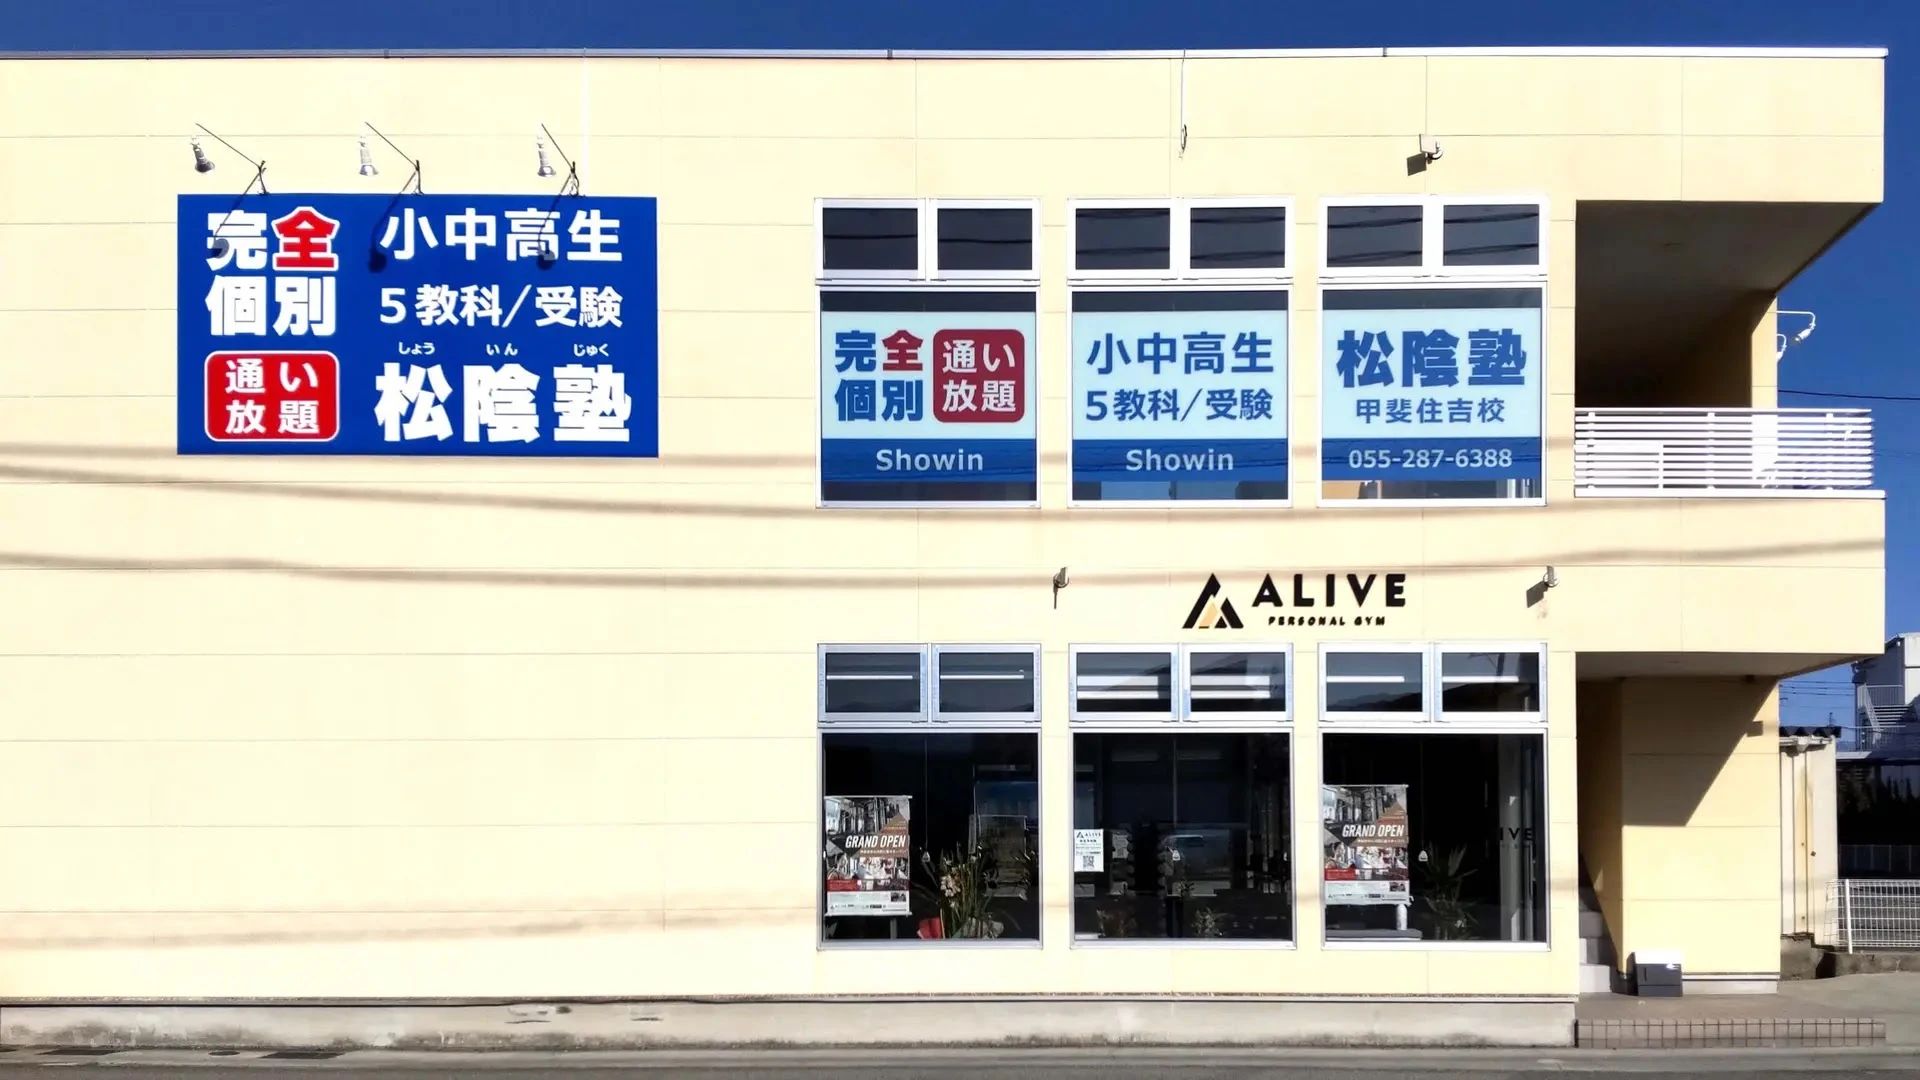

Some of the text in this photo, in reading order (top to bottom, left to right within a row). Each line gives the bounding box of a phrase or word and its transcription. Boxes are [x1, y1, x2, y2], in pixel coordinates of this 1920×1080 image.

[207, 207, 339, 271] 完全
[380, 208, 622, 261] 小中高生
[206, 275, 336, 336] 個別
[398, 342, 609, 356] しょう いん じゅく
[835, 330, 923, 372] 完全
[942, 339, 1016, 373] 通い
[1087, 331, 1274, 375] 小中高生
[1337, 329, 1527, 388] 松陰塾
[225, 358, 319, 394] 通い
[375, 363, 631, 442] 松陰塾
[835, 379, 923, 421] 個別
[942, 379, 1016, 412] 放題
[1356, 398, 1505, 424] 甲斐住吉校
[225, 399, 319, 434] 放題
[876, 448, 983, 471] Showin
[1126, 448, 1234, 471] Showin
[1349, 449, 1513, 468] 055-287-6388
[1252, 573, 1406, 607] ALIVE
[1268, 616, 1386, 626] PERSONAL GYM
[845, 835, 907, 848] GRAND OPEN
[1342, 825, 1405, 837] GRAND OPEN
